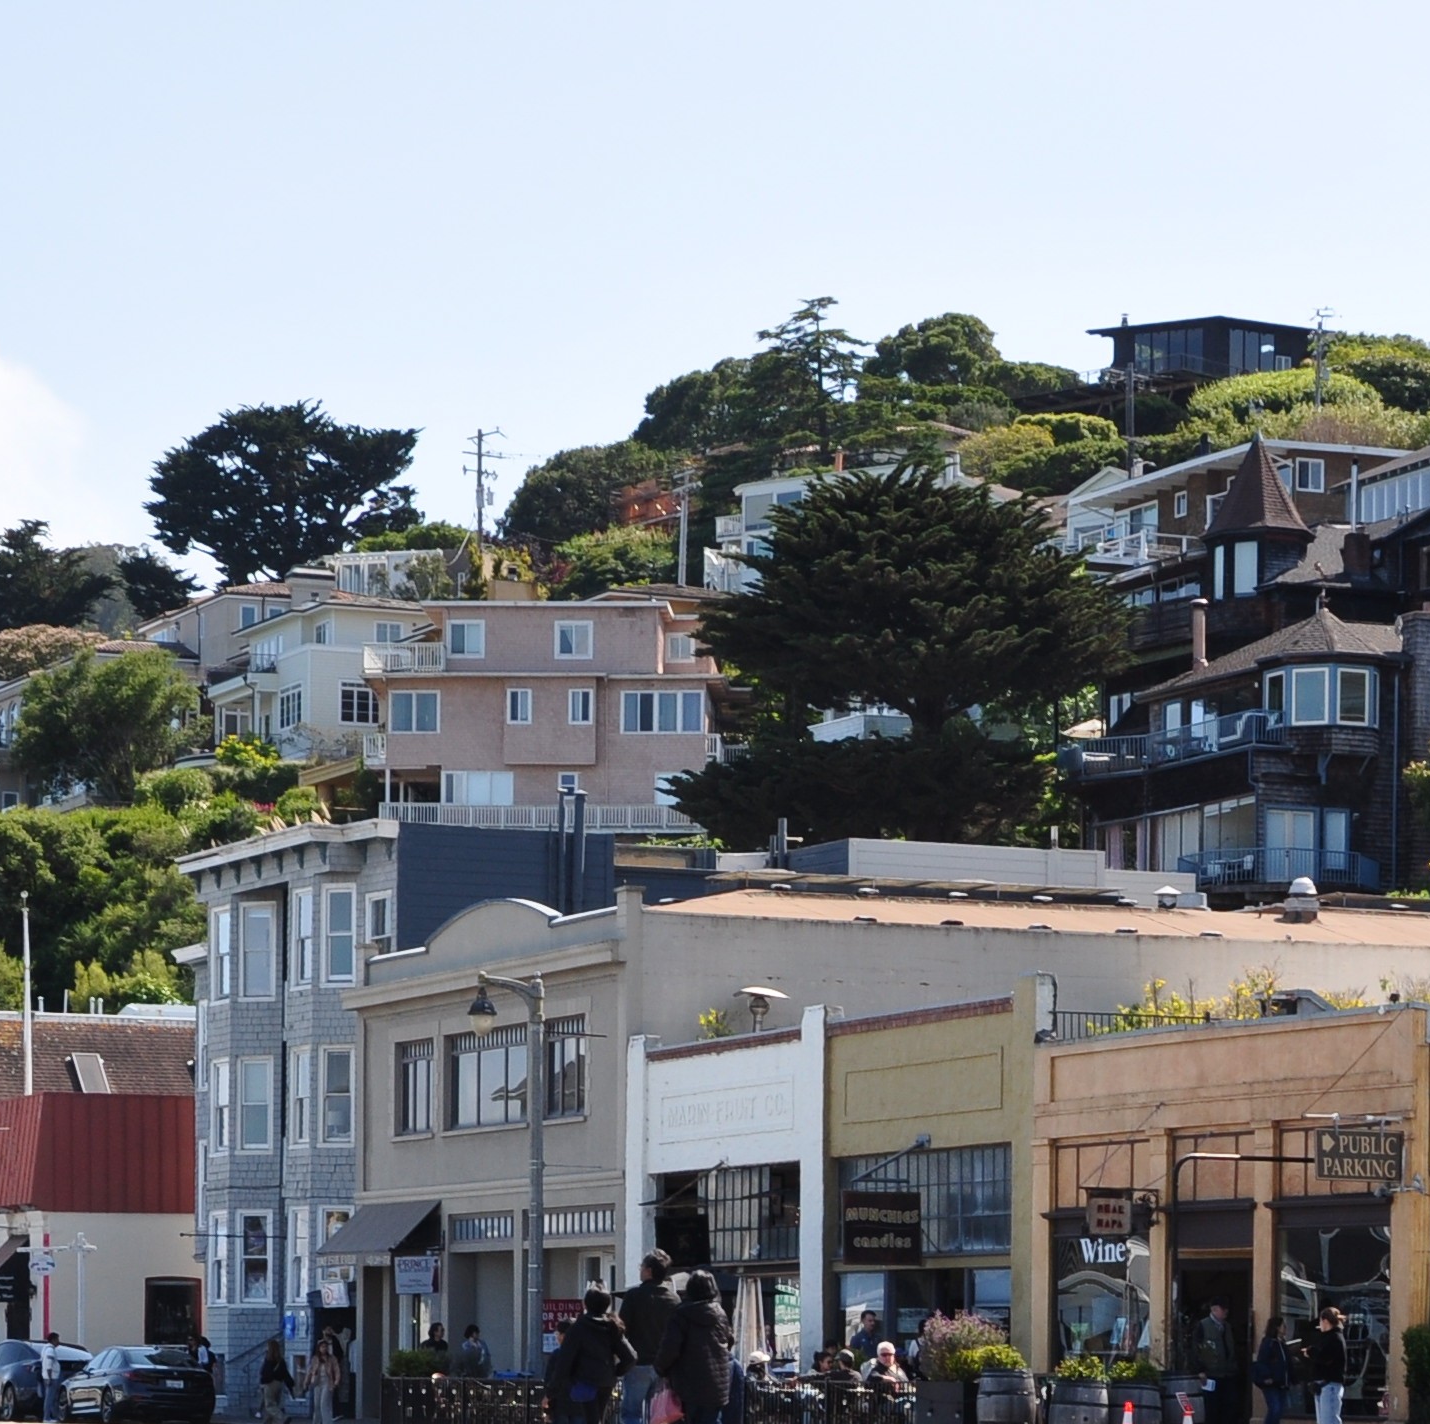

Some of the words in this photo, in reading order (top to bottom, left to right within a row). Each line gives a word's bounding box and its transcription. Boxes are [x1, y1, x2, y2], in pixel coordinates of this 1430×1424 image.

[765, 1093, 788, 1116] CO.
[1339, 1135, 1397, 1155] PUBLIC
[1323, 1157, 1396, 1178] PARKING
[845, 1207, 919, 1224] MUNCHIES
[1097, 1204, 1125, 1214] REAL
[1096, 1218, 1123, 1228] NAPA
[853, 1232, 912, 1249] candies
[1079, 1237, 1126, 1264] Wine
[542, 1302, 582, 1311] UILDING
[542, 1312, 555, 1320] OR
